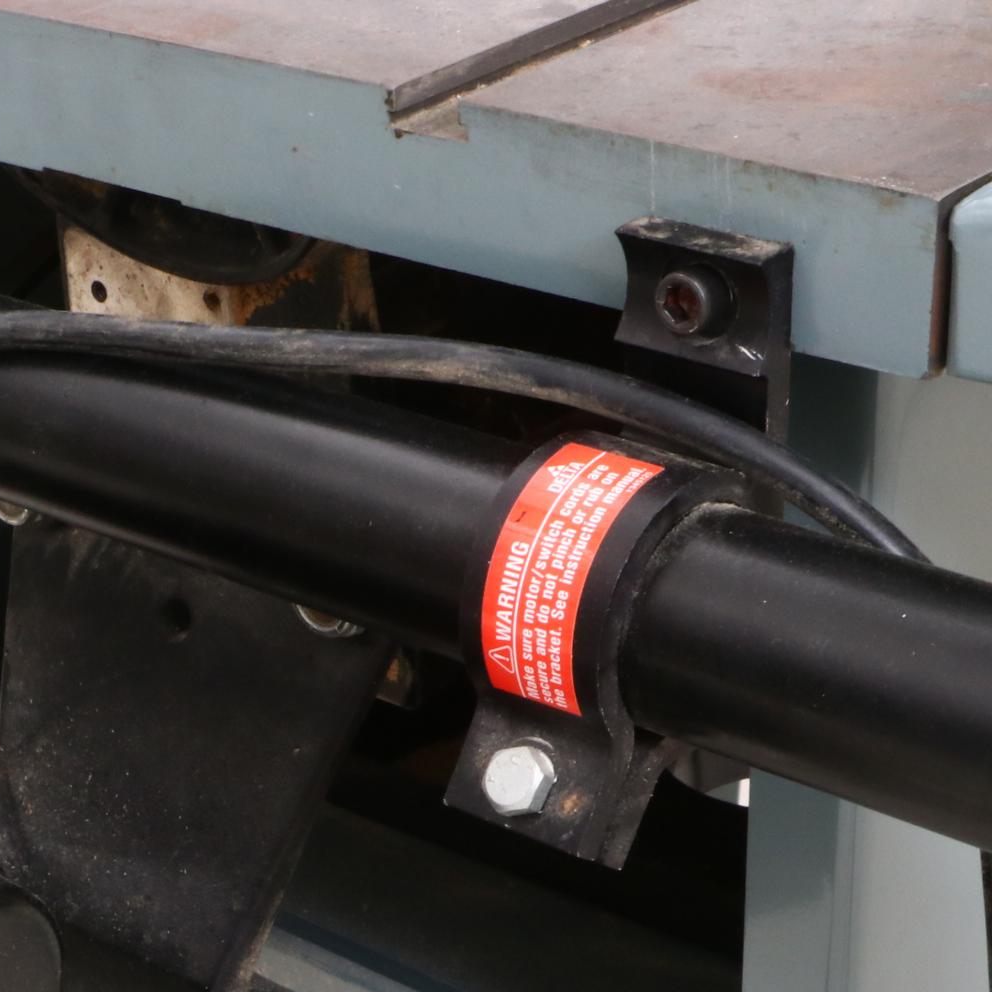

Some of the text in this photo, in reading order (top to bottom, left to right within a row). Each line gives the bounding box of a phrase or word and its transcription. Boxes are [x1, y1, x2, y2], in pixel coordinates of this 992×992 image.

[547, 462, 586, 494] DELTA
[603, 467, 648, 505] manual.
[560, 507, 608, 585] instruction
[495, 541, 530, 642] WARNING
[522, 464, 610, 700] Make sure motor/switch cords are
[535, 471, 620, 704] secure and do not pinch or rub on
[551, 590, 570, 621] See
[548, 627, 563, 686] bracket.
